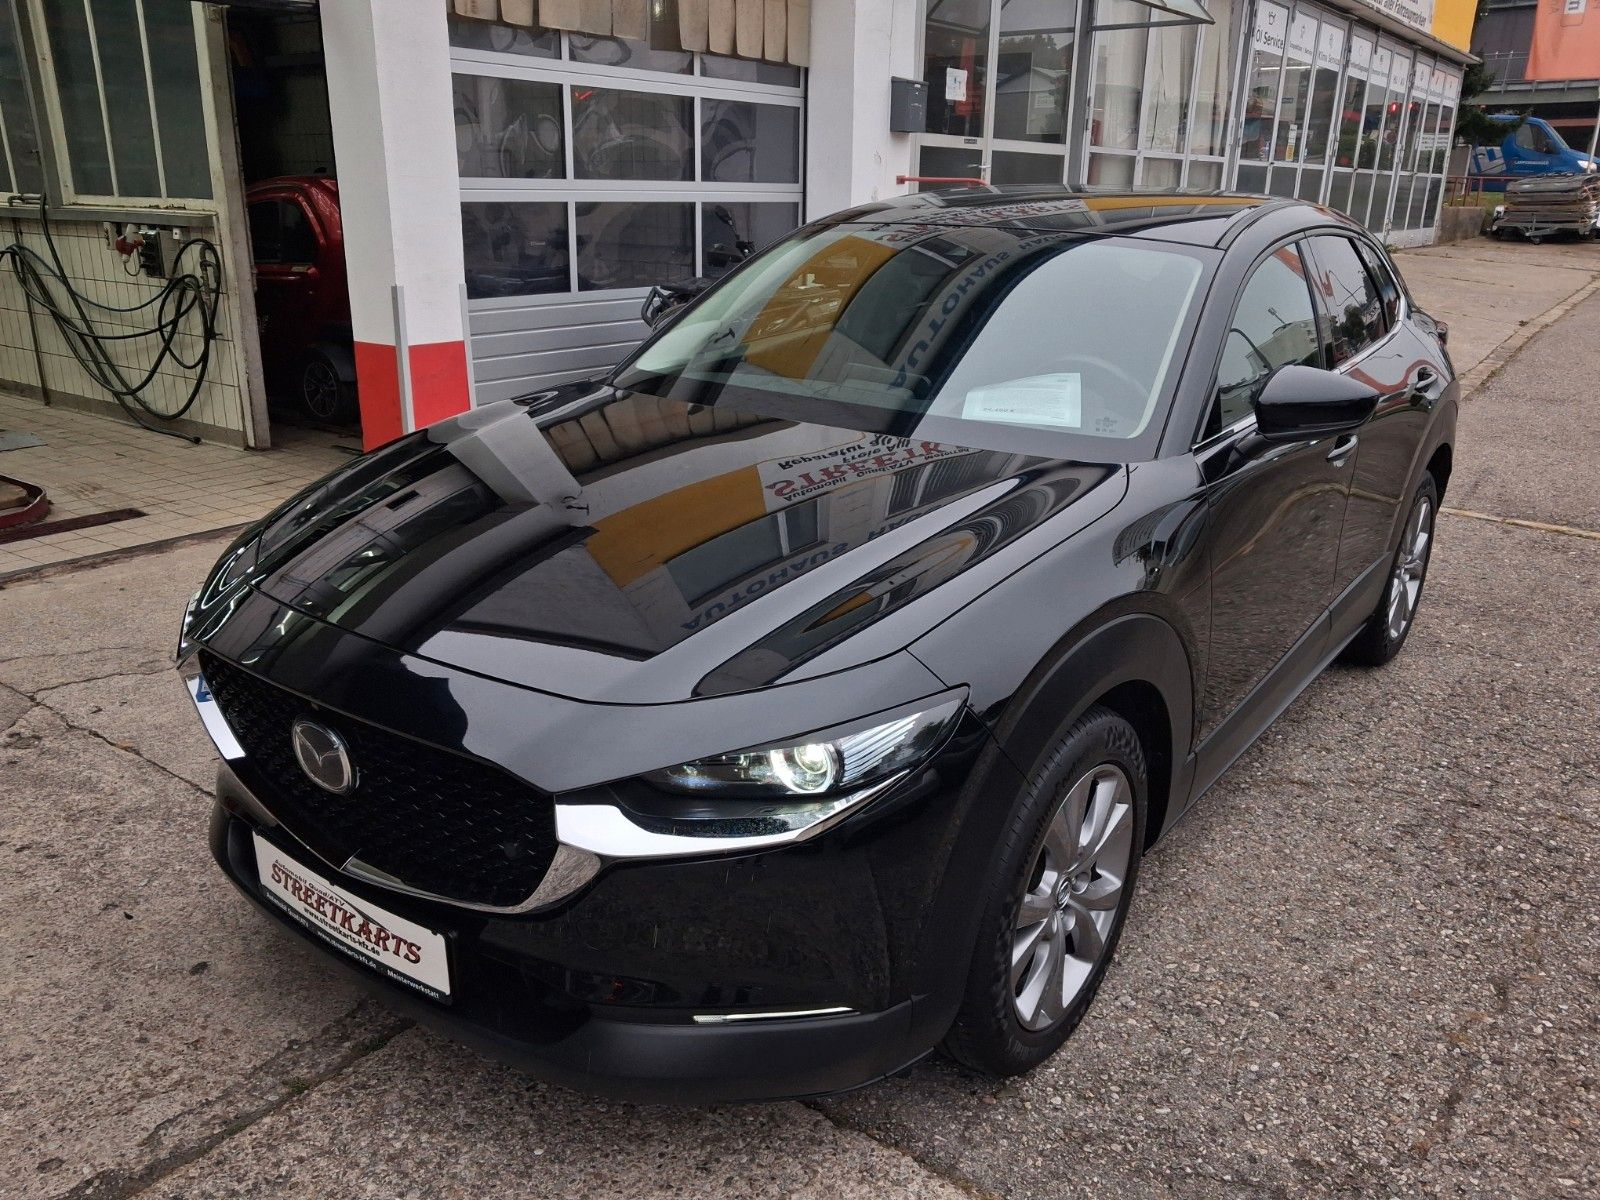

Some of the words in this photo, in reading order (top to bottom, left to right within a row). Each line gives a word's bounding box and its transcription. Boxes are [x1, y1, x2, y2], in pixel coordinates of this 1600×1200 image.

[1256, 25, 1263, 44] Öl
[1264, 31, 1284, 50] Service
[271, 862, 422, 965] STREETKARTS
